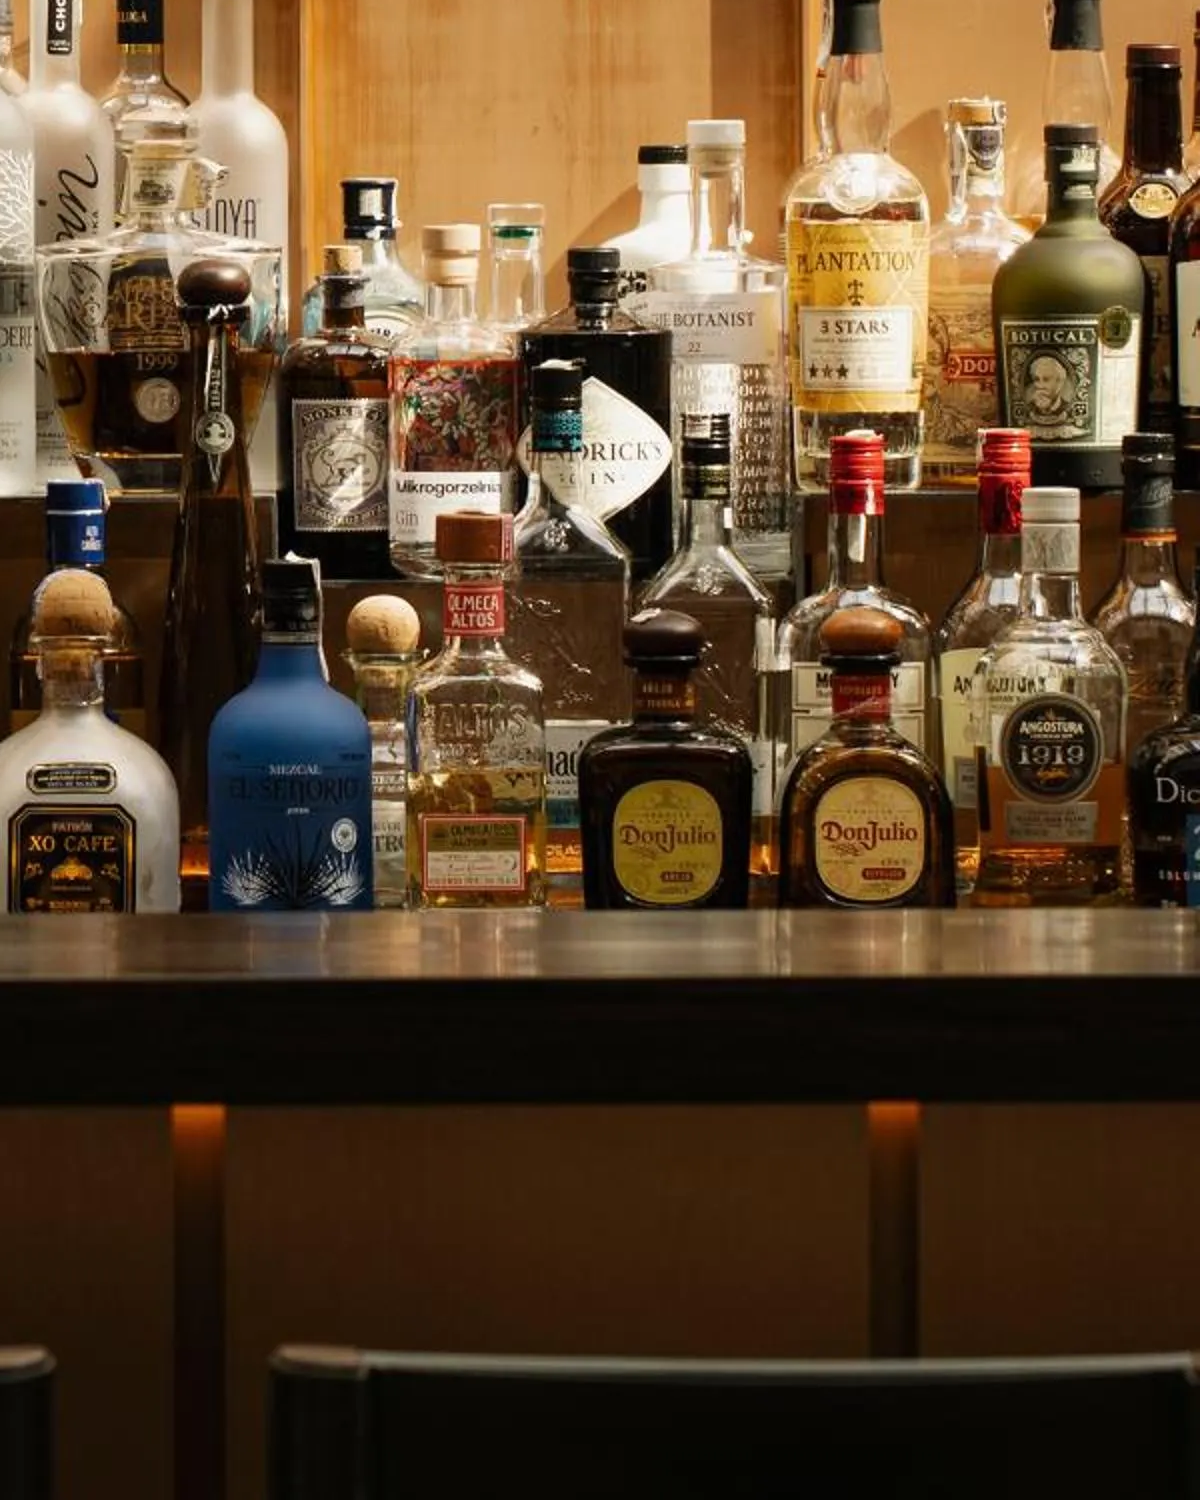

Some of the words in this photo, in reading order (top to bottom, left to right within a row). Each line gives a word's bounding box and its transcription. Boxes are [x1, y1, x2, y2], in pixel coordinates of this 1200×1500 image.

[798, 251, 917, 274] PLANTATION
[673, 311, 756, 328] BOTANIST
[820, 321, 829, 334] 3
[835, 319, 890, 335] STARS
[1011, 331, 1088, 343] BOTUCAL
[448, 593, 499, 612] OLMECA
[452, 611, 495, 628] ALTOS
[1019, 720, 1085, 735] ANGOSTURA
[1017, 744, 1085, 766] 1919
[268, 763, 322, 776] MEZCAL
[29, 834, 56, 852] XO
